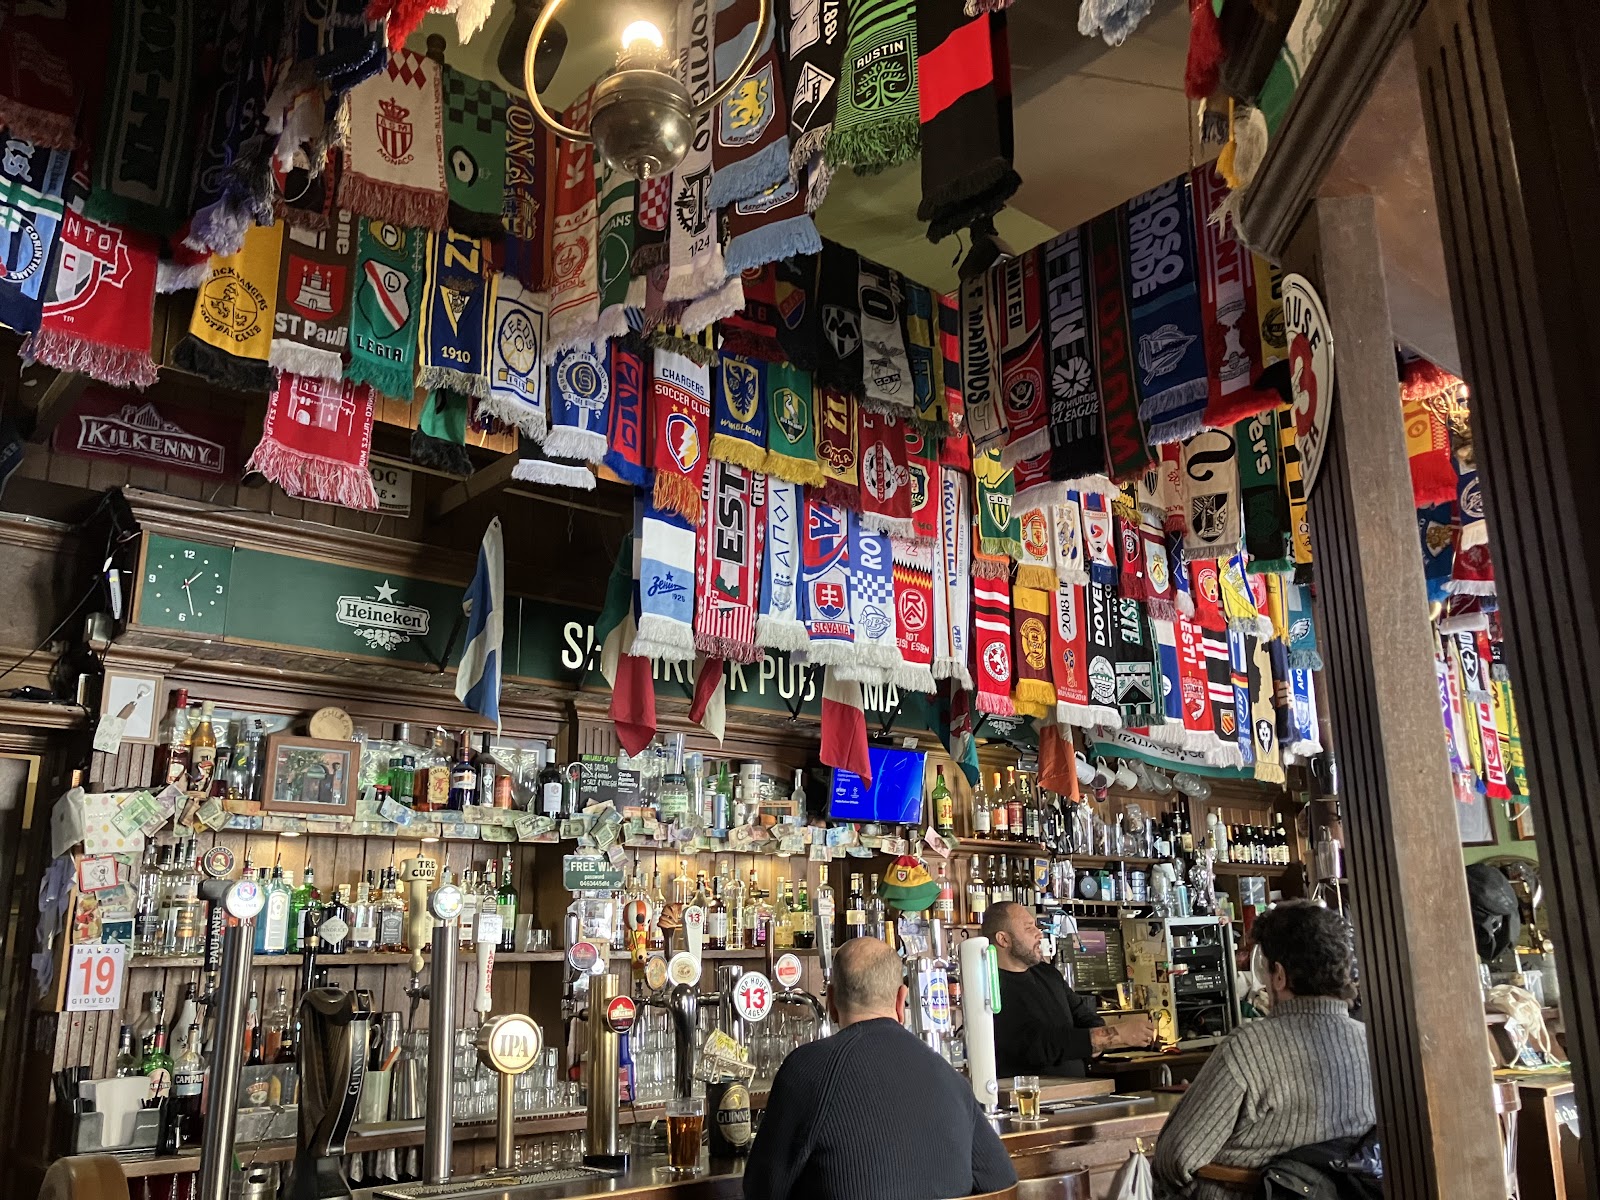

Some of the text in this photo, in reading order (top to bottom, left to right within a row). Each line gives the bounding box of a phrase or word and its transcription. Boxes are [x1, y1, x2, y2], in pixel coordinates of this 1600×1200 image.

[857, 40, 904, 68] AUSTIN
[376, 148, 415, 166] MONACO
[11, 225, 42, 280] CORINTHIANS
[1007, 258, 1023, 330] UNITED
[275, 312, 348, 347] ST Pauli
[503, 318, 534, 350] LEEDS
[356, 334, 404, 362] LEGIA
[441, 346, 471, 363] 1910
[735, 354, 748, 364] AFC
[968, 308, 990, 405] MARINOS
[662, 367, 705, 396] CHARGERS
[655, 384, 711, 418] SOCCER CLUB
[720, 418, 762, 437] WIMBLEDON
[87, 424, 211, 465] KILKENNY
[989, 494, 1011, 503] CDT
[716, 463, 746, 565] EST
[183, 549, 195, 560] 12
[149, 573, 156, 584] 9
[216, 584, 223, 596] 3
[178, 612, 186, 623] 6
[345, 603, 422, 628] Heineken
[1060, 600, 1072, 634] 2018
[813, 622, 850, 635] SLOVAKIA
[208, 846, 233, 859] PAULANER
[418, 860, 436, 869] TRE
[570, 862, 595, 872] FREE
[689, 914, 700, 924] 13
[209, 907, 222, 964] PAULANER
[79, 955, 115, 996] 19
[740, 979, 749, 995] HOP
[741, 988, 766, 1009] 13
[745, 1007, 765, 1017] LAGER
[498, 1034, 529, 1058] IPA
[348, 1037, 363, 1095] GUINNESS
